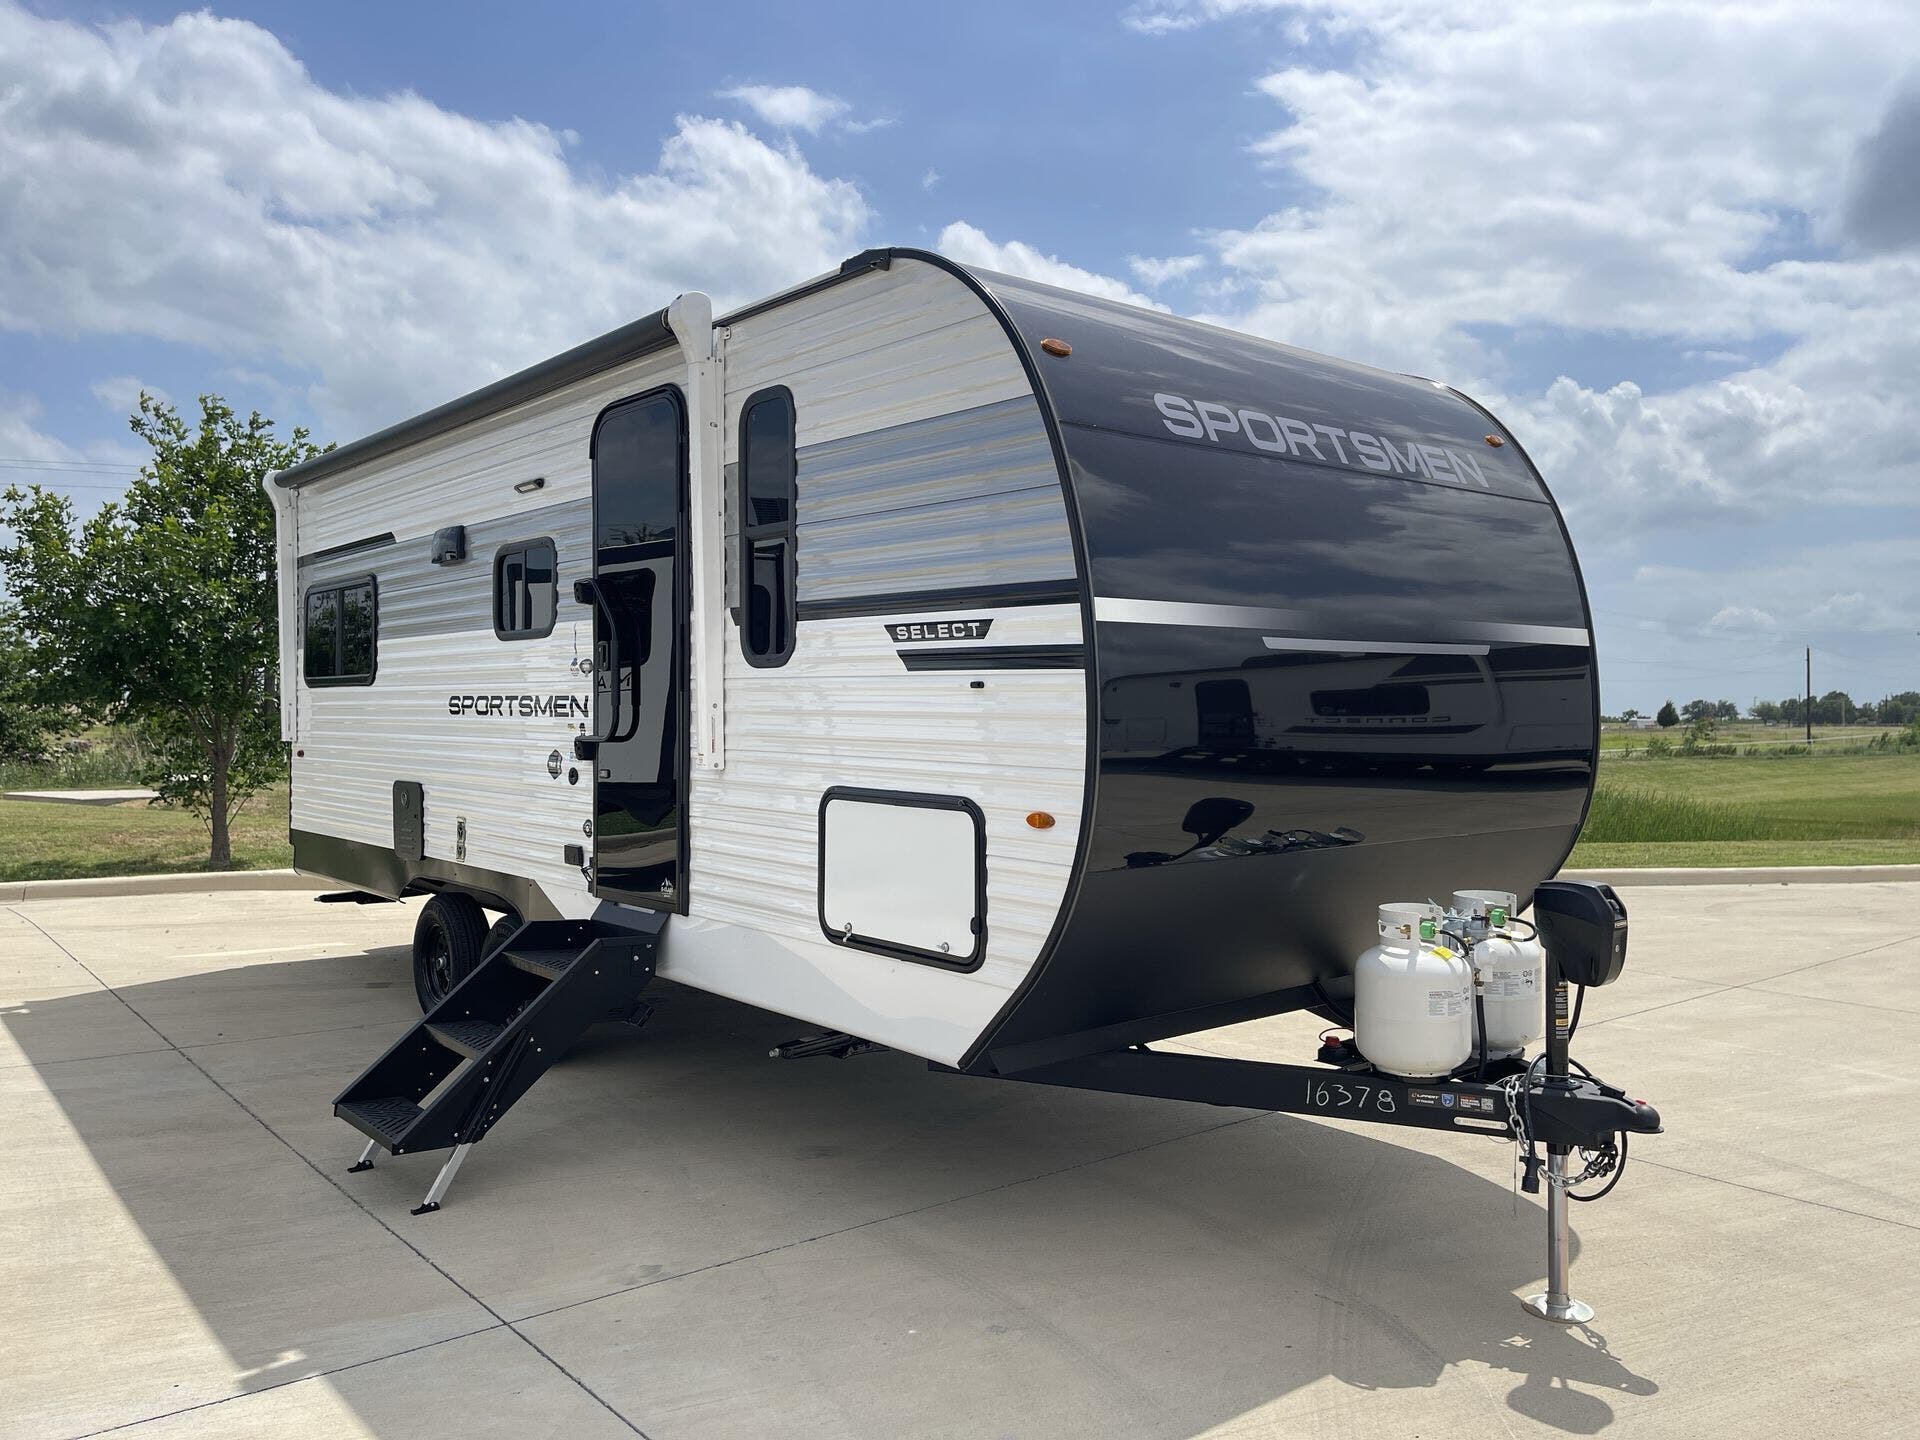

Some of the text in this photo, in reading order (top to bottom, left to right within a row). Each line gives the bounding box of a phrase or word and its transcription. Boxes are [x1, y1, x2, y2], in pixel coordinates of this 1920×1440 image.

[1153, 392, 1490, 489] SPORTSMEN
[896, 622, 980, 640] SELECT
[448, 695, 589, 718] SPORTSMEN
[1305, 1078, 1396, 1113] 16378
